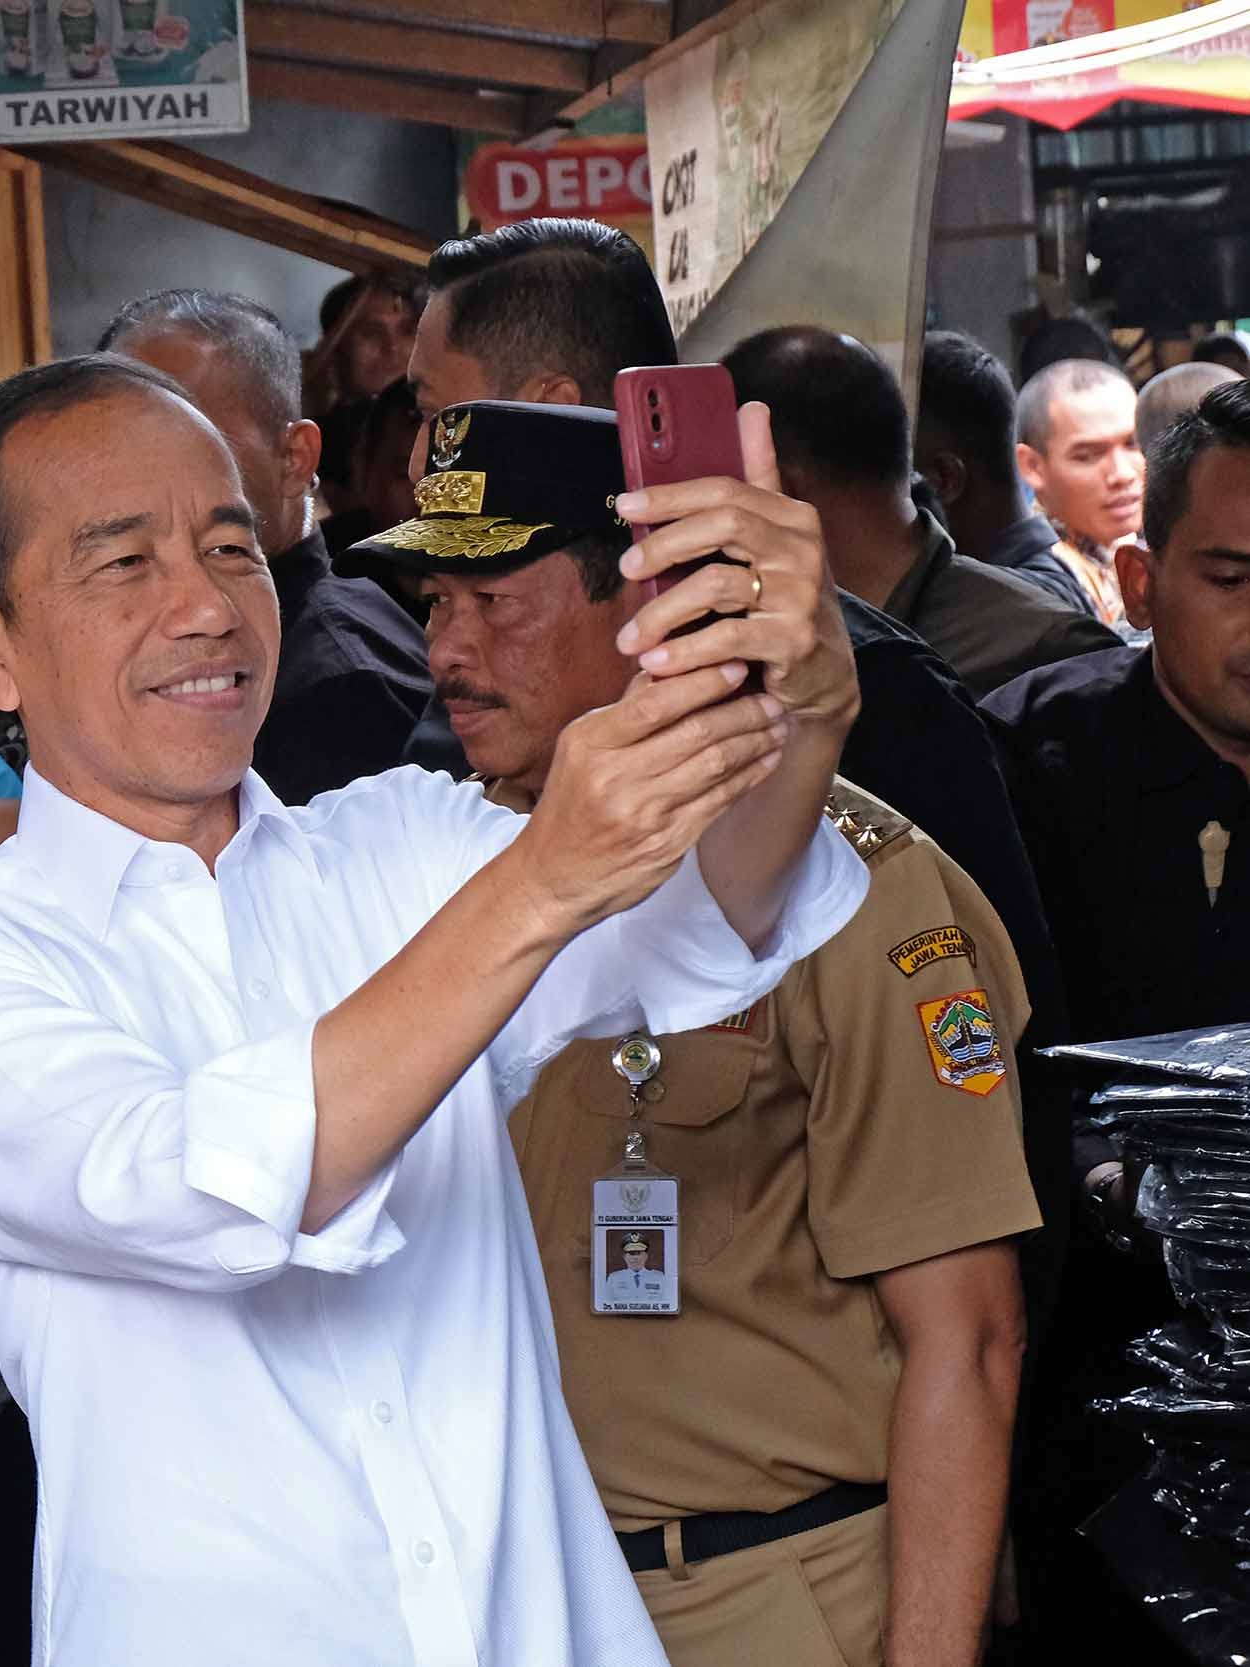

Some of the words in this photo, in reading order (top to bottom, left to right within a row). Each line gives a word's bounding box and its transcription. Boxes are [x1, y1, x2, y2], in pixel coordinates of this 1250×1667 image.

[5, 90, 210, 128] TARWIYAH
[892, 930, 959, 963] PEMERINTAH
[910, 947, 938, 969] JAWA
